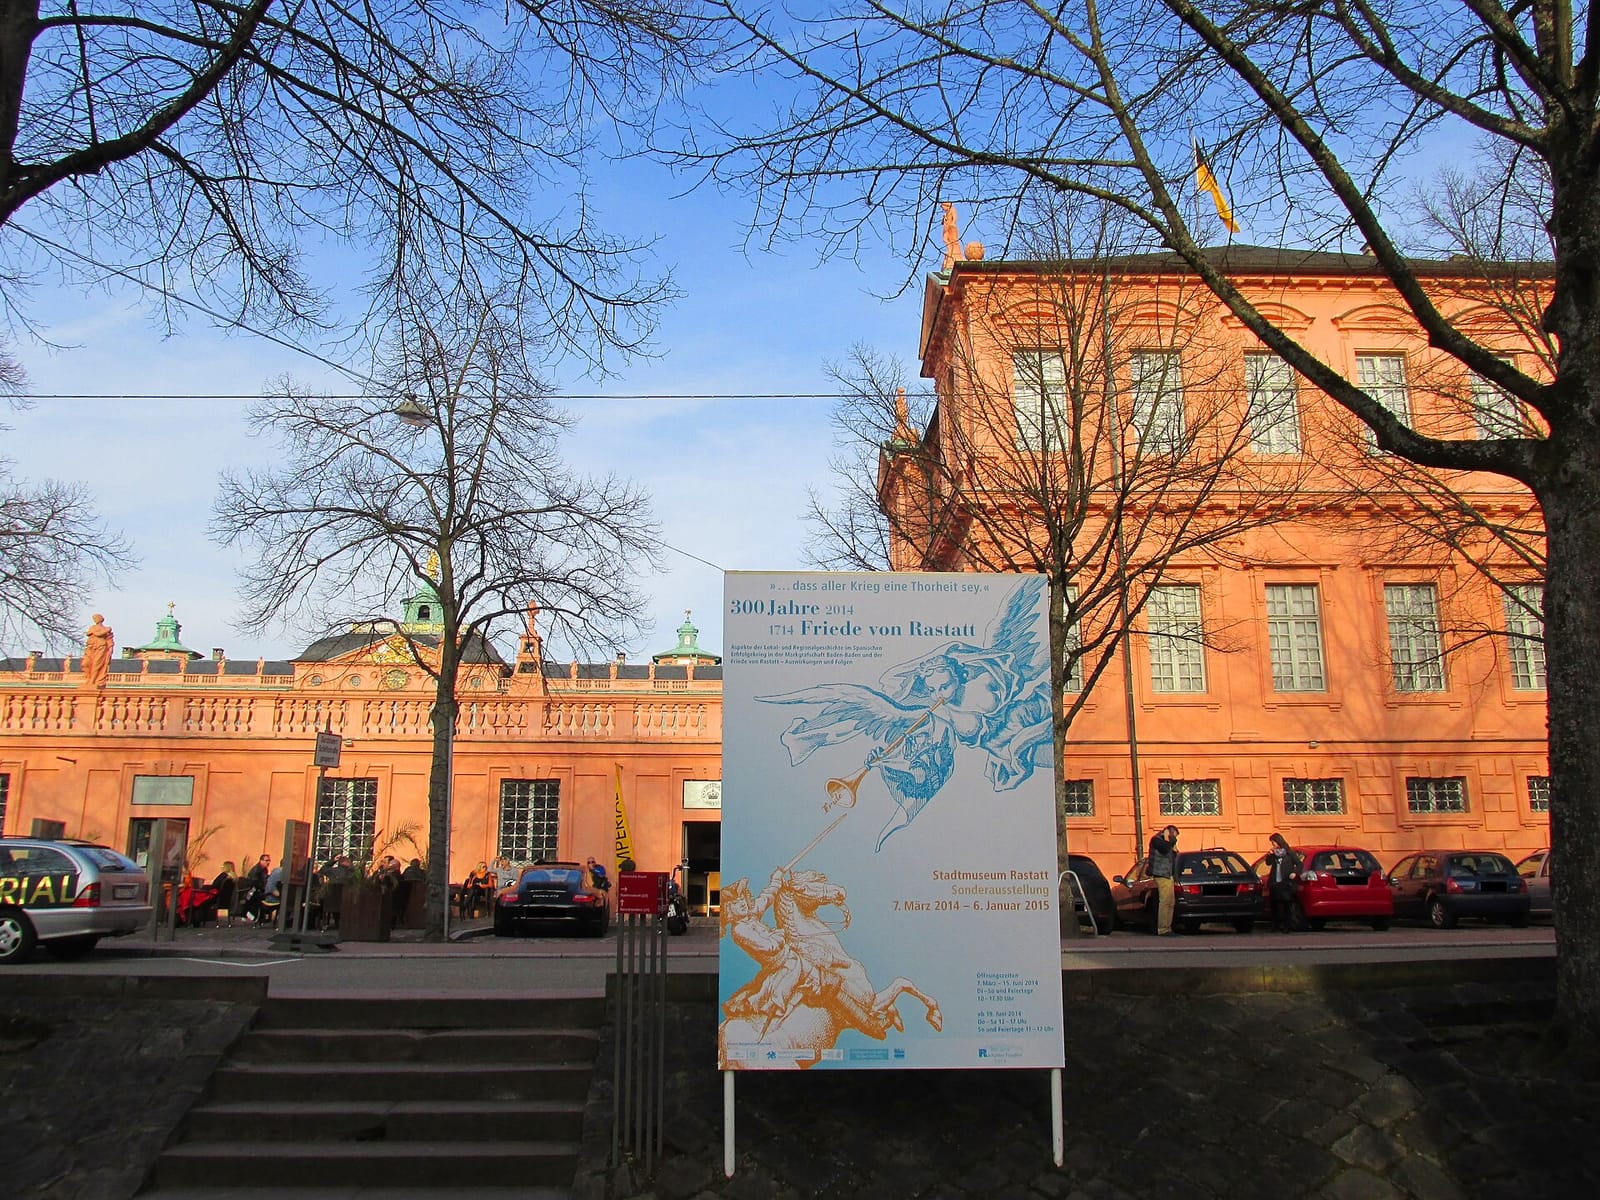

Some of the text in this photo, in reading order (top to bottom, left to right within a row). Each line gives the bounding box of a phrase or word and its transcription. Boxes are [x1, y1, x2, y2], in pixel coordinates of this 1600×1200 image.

[792, 580, 818, 591] dass
[821, 580, 846, 591] aller
[850, 580, 880, 594] Krieg
[884, 581, 908, 592] eine
[911, 581, 958, 592] Thorheit
[730, 599, 855, 616] 300 Jahre 2014
[769, 620, 976, 637] 1714 Friede von Rastatt
[932, 870, 1049, 881] Stadtmuseum Rastatt
[951, 884, 1050, 898] Sonderausstellung
[893, 900, 901, 911] 7.
[904, 900, 931, 911] März
[935, 900, 960, 911] 2014
[973, 900, 983, 911] 6.
[986, 900, 1021, 911] Januar
[1024, 900, 1050, 911] 2015
